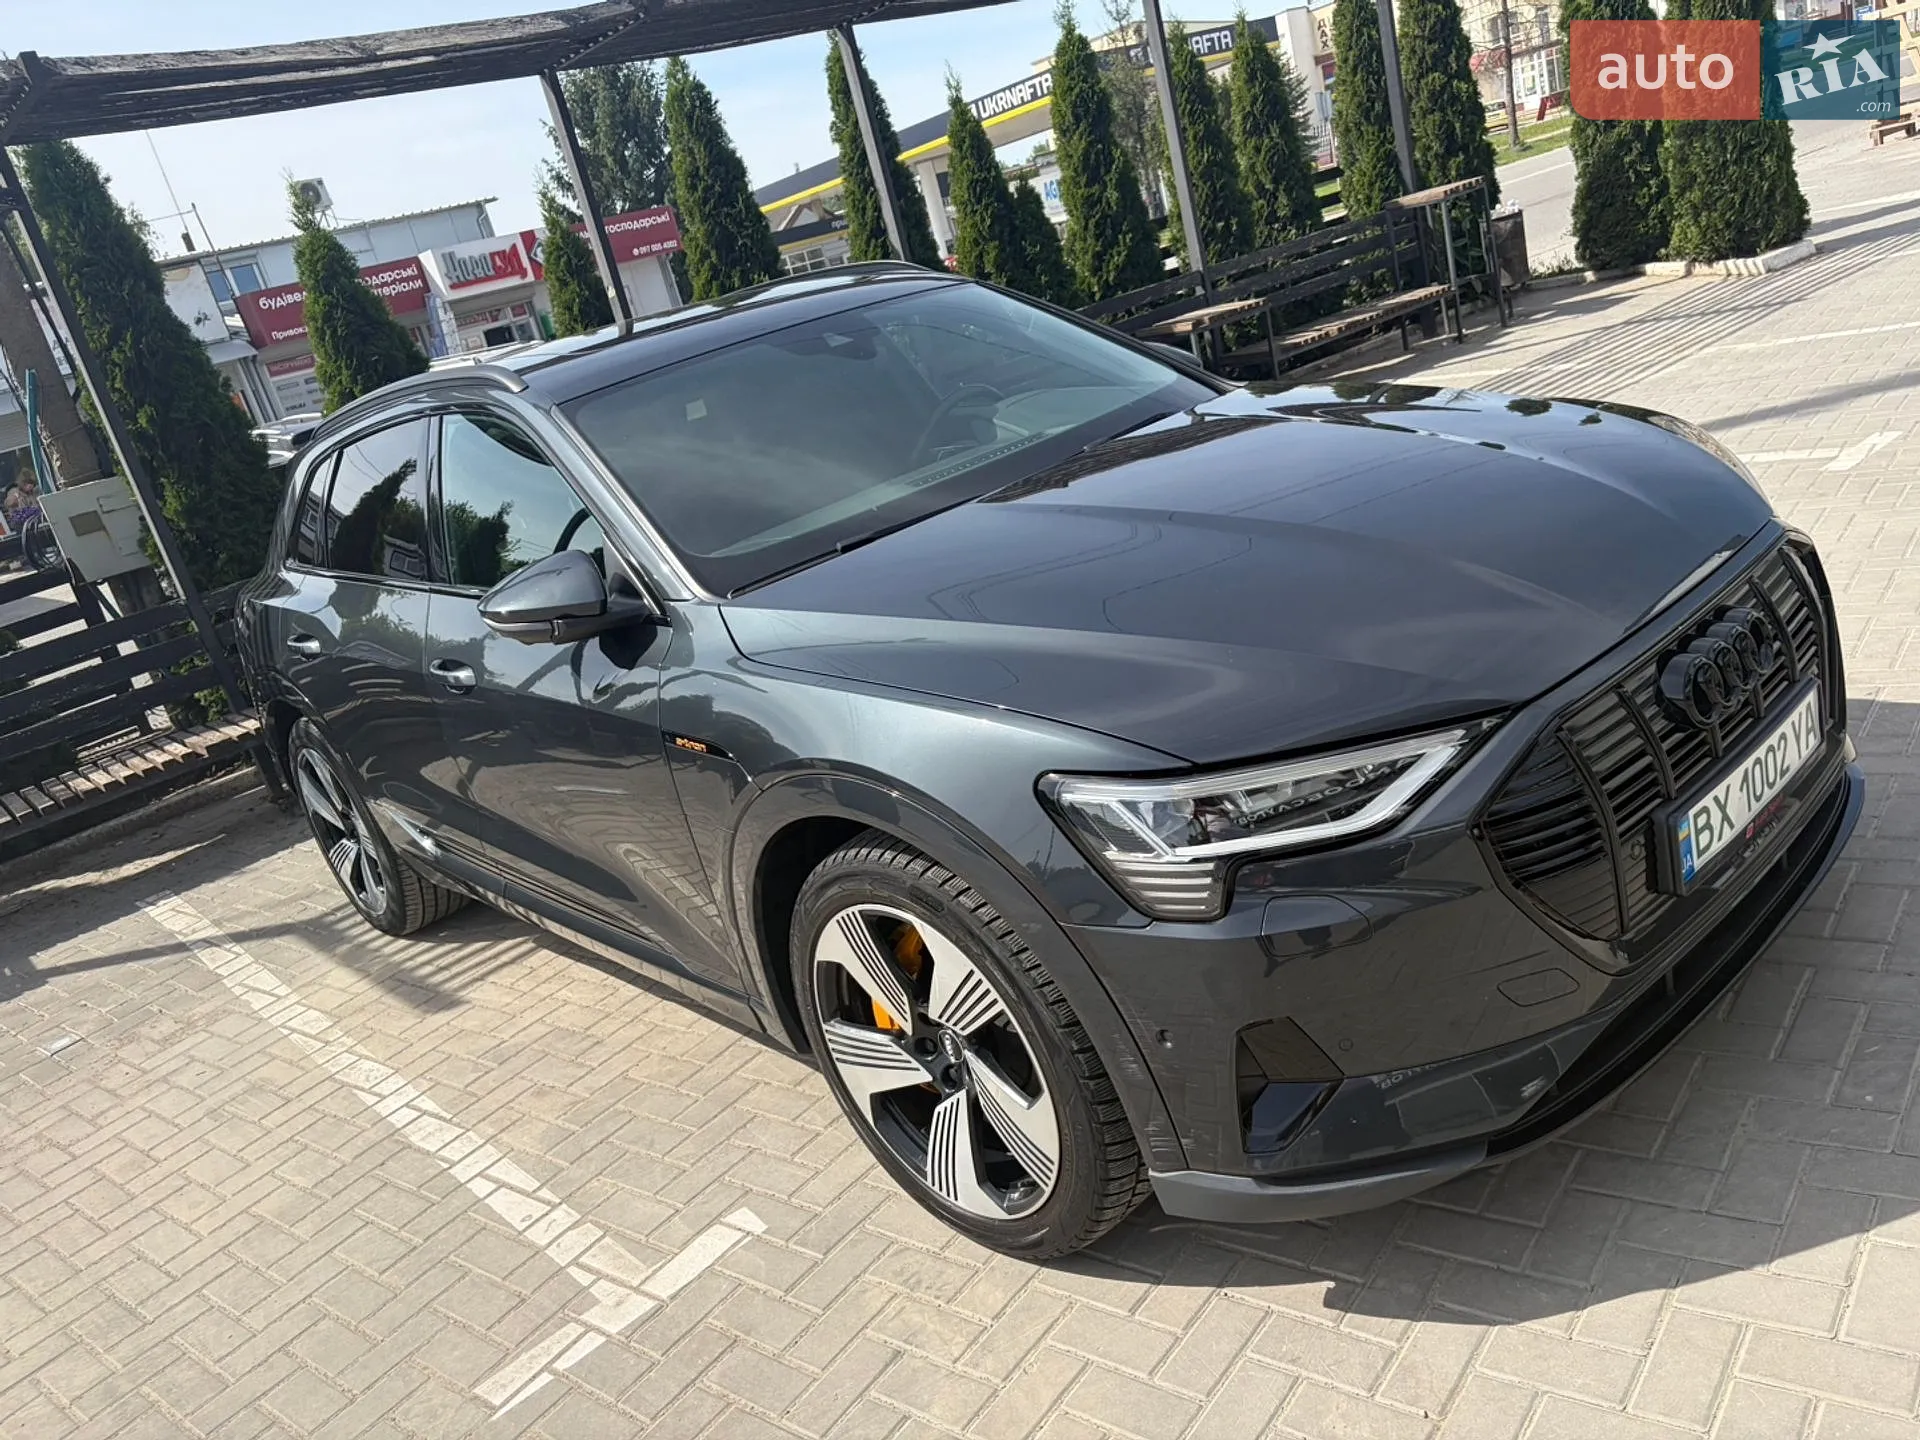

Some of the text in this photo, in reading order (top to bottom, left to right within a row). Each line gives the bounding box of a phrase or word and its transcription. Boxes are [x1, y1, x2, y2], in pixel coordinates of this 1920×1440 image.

[978, 73, 1053, 118] UKRNAFTA
[258, 290, 309, 310] будівел
[1693, 783, 1735, 859] BX
[1739, 731, 1790, 813] 1002
[1791, 701, 1818, 760] YA
